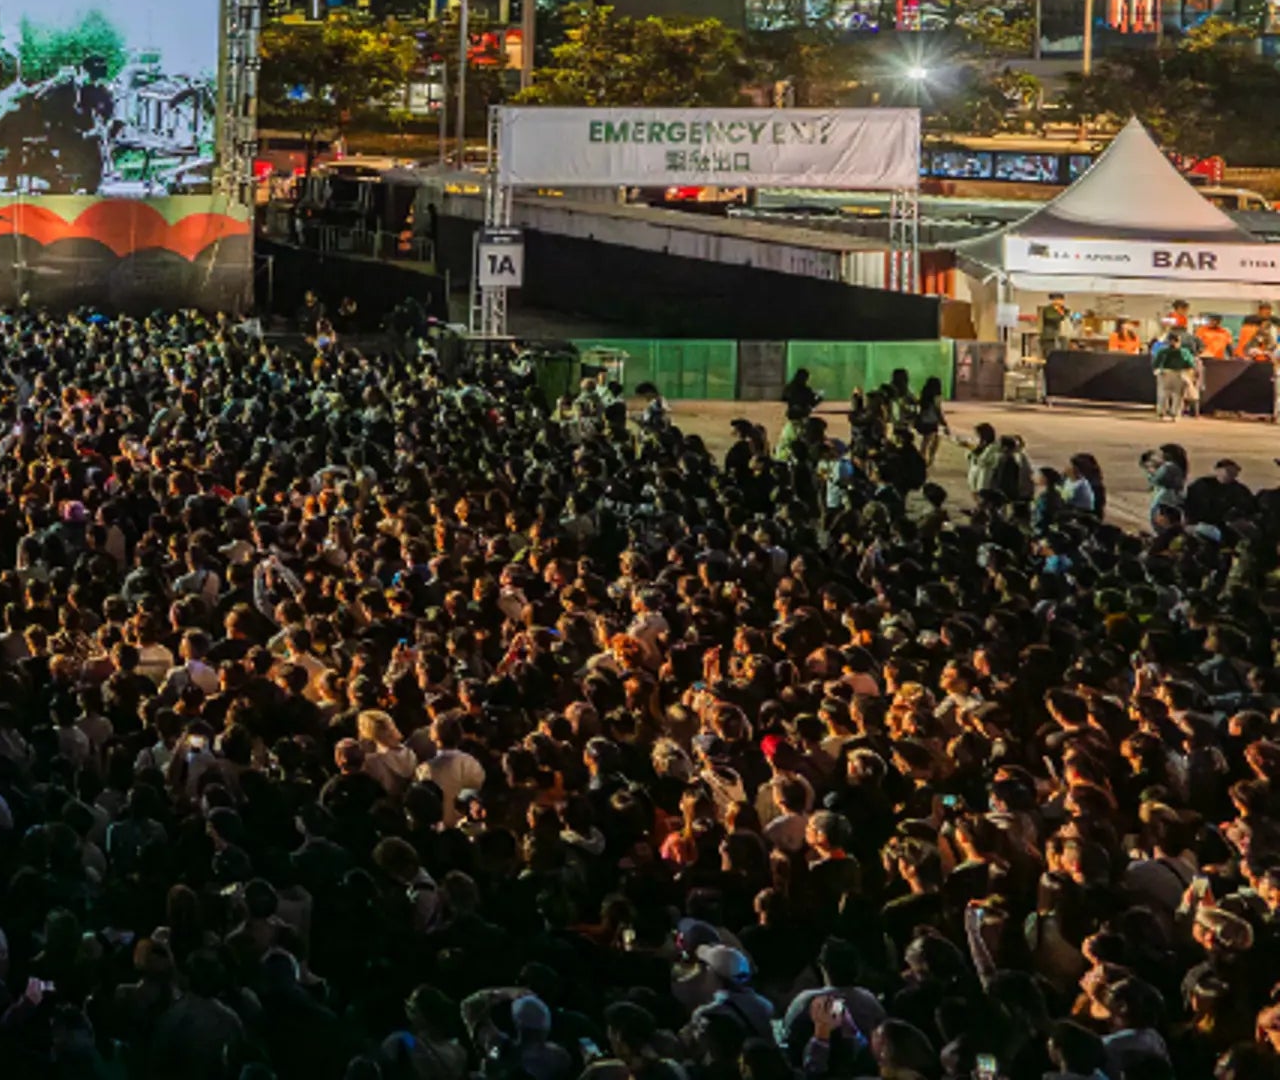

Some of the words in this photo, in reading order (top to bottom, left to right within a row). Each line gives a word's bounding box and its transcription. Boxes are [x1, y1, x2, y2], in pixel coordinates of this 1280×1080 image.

[589, 120, 767, 145] EMERGENCY
[487, 254, 516, 276] 1A
[1152, 250, 1218, 270] BAR
